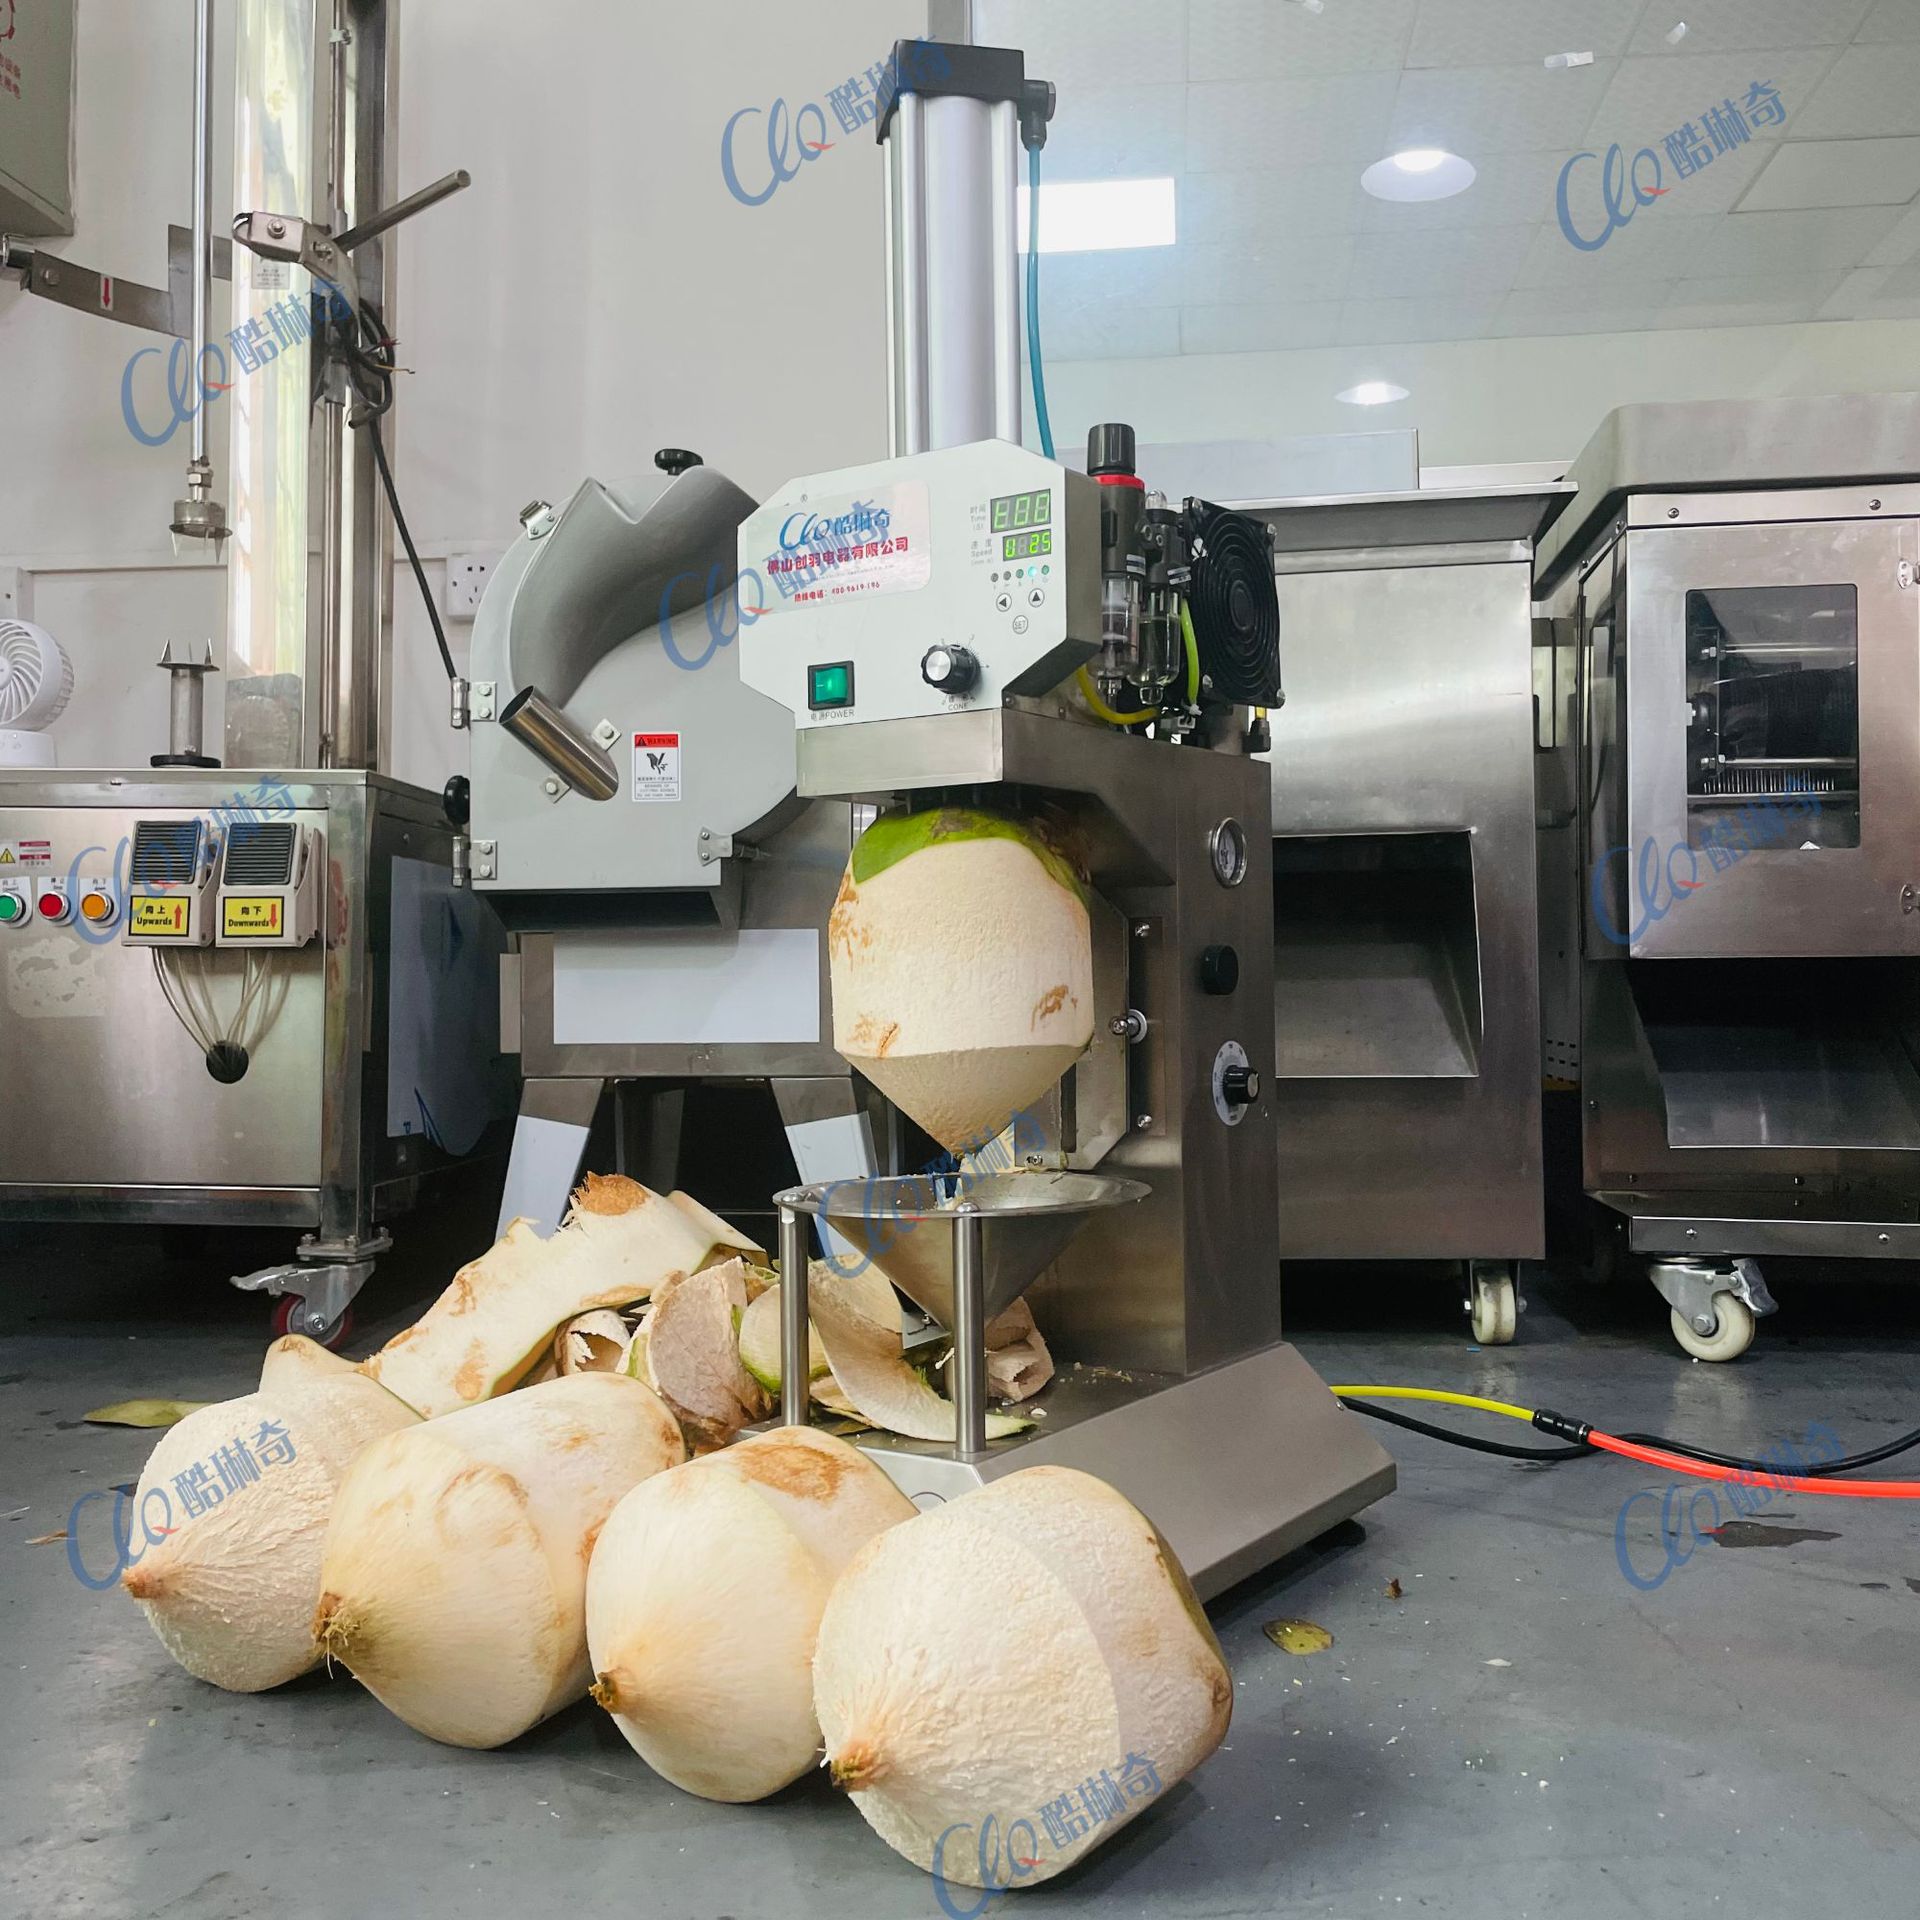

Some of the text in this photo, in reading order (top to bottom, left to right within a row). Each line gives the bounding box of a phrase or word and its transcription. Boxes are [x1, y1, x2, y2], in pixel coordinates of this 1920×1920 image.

[834, 508, 892, 536] 酷琳奇
[767, 536, 909, 575] 佛山创羽电器有限公司
[824, 708, 855, 720] POWER
[646, 737, 676, 745] WARNING
[145, 905, 166, 915] 向上
[241, 906, 262, 916] 向下
[136, 916, 173, 927] Upwards
[228, 918, 269, 928] Downwards
